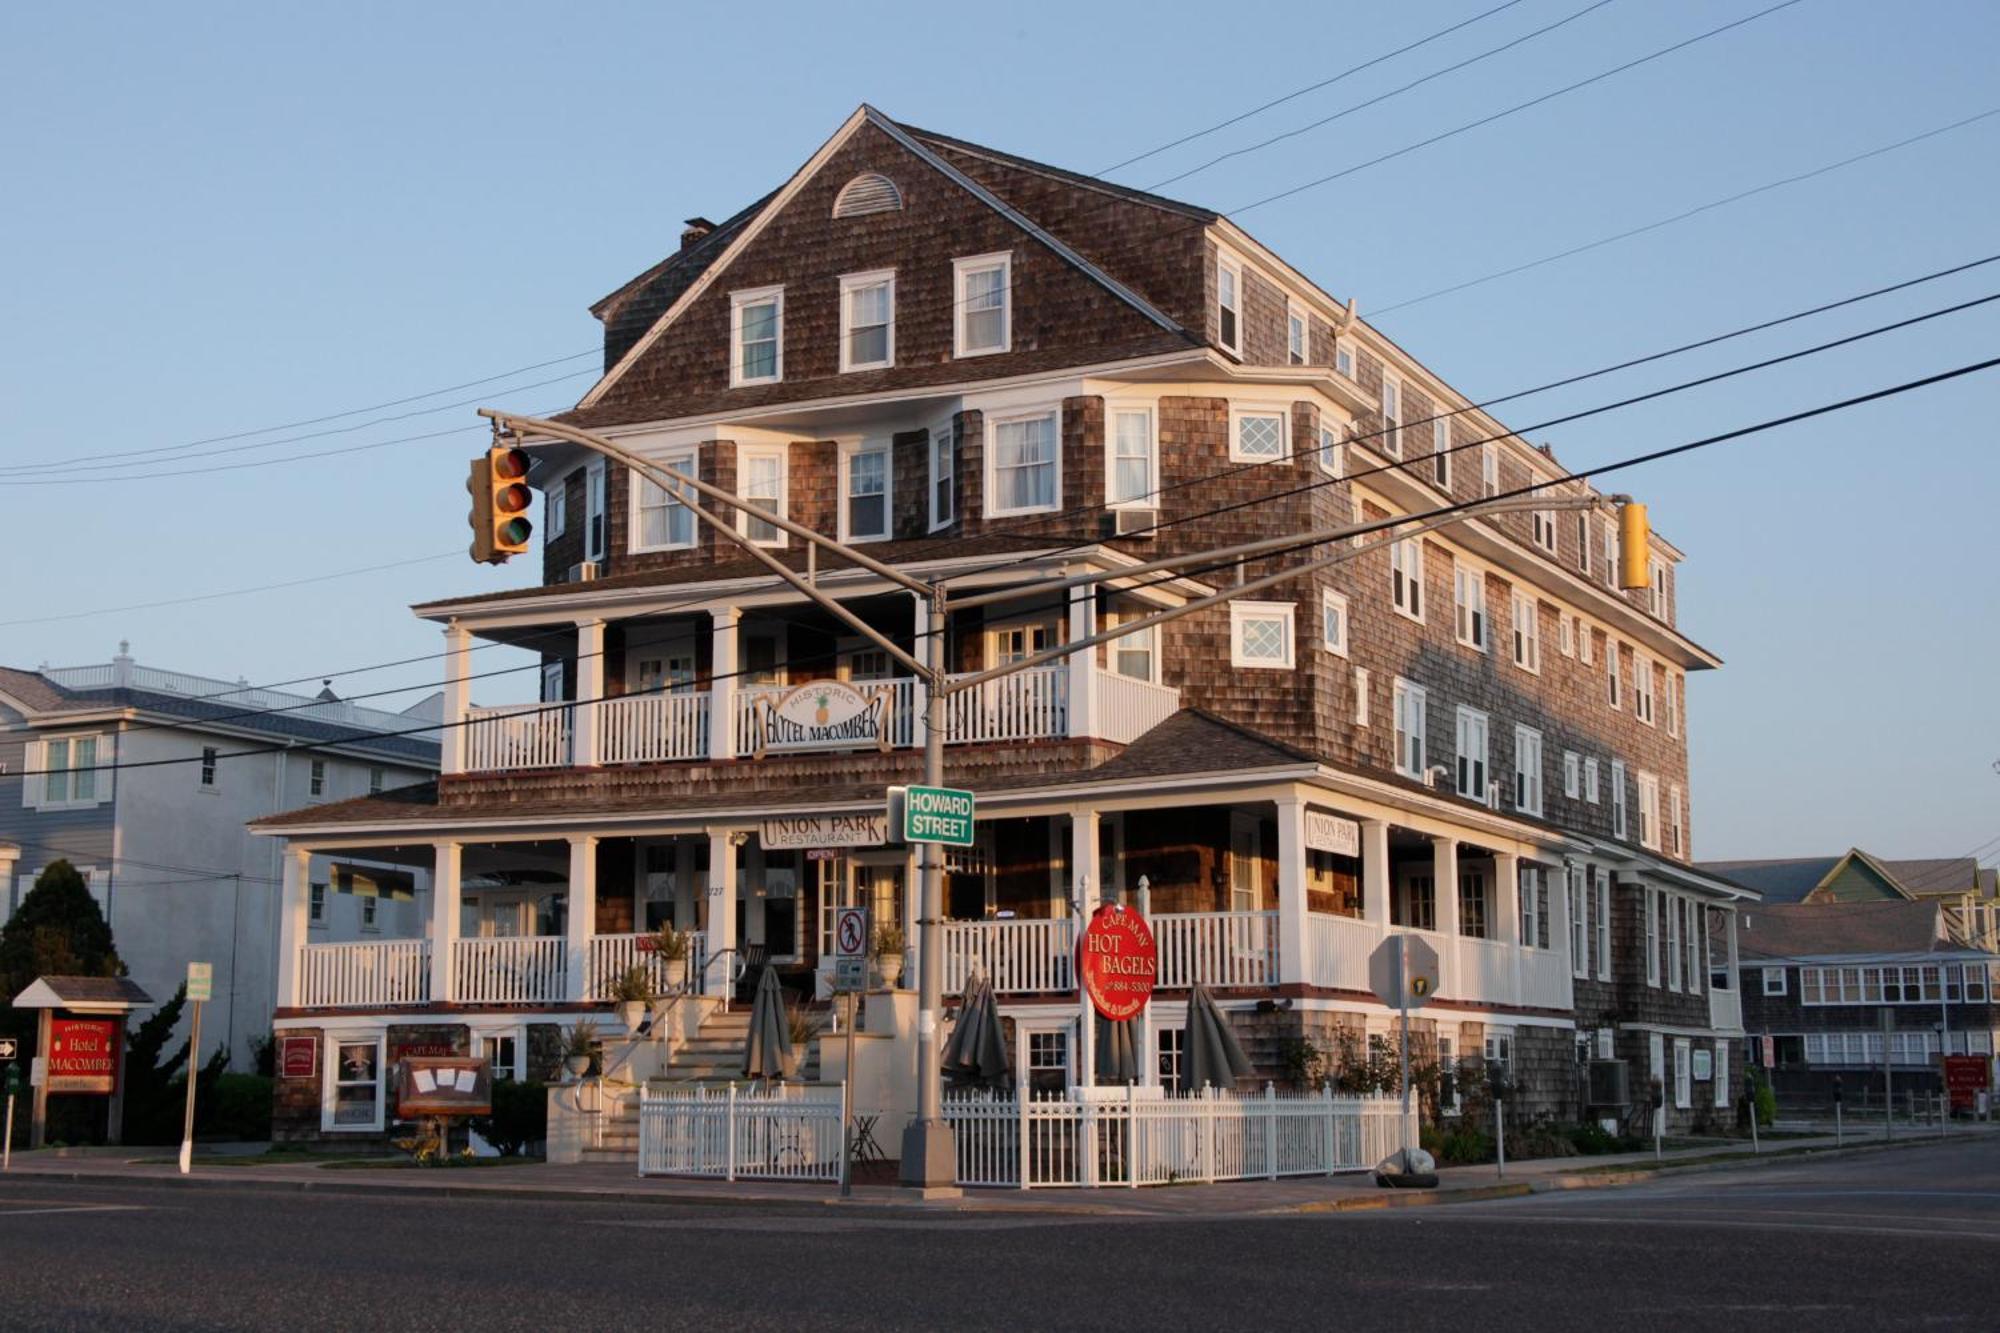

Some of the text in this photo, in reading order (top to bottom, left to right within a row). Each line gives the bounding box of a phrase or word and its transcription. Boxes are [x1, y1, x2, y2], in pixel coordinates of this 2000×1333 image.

[789, 685, 857, 708] HISTORIC
[766, 697, 882, 743] HOTEL MACOMBER
[909, 792, 970, 816] HOWARD
[763, 815, 880, 846] UNION PARK
[912, 814, 967, 838] STREET
[1306, 815, 1336, 845] UNION
[780, 832, 861, 846] RESTAURANT
[1102, 914, 1148, 947] CAPE MAY
[1088, 933, 1122, 953] HOT
[1103, 955, 1155, 975] BAGELS
[70, 1038, 97, 1051] Hotel
